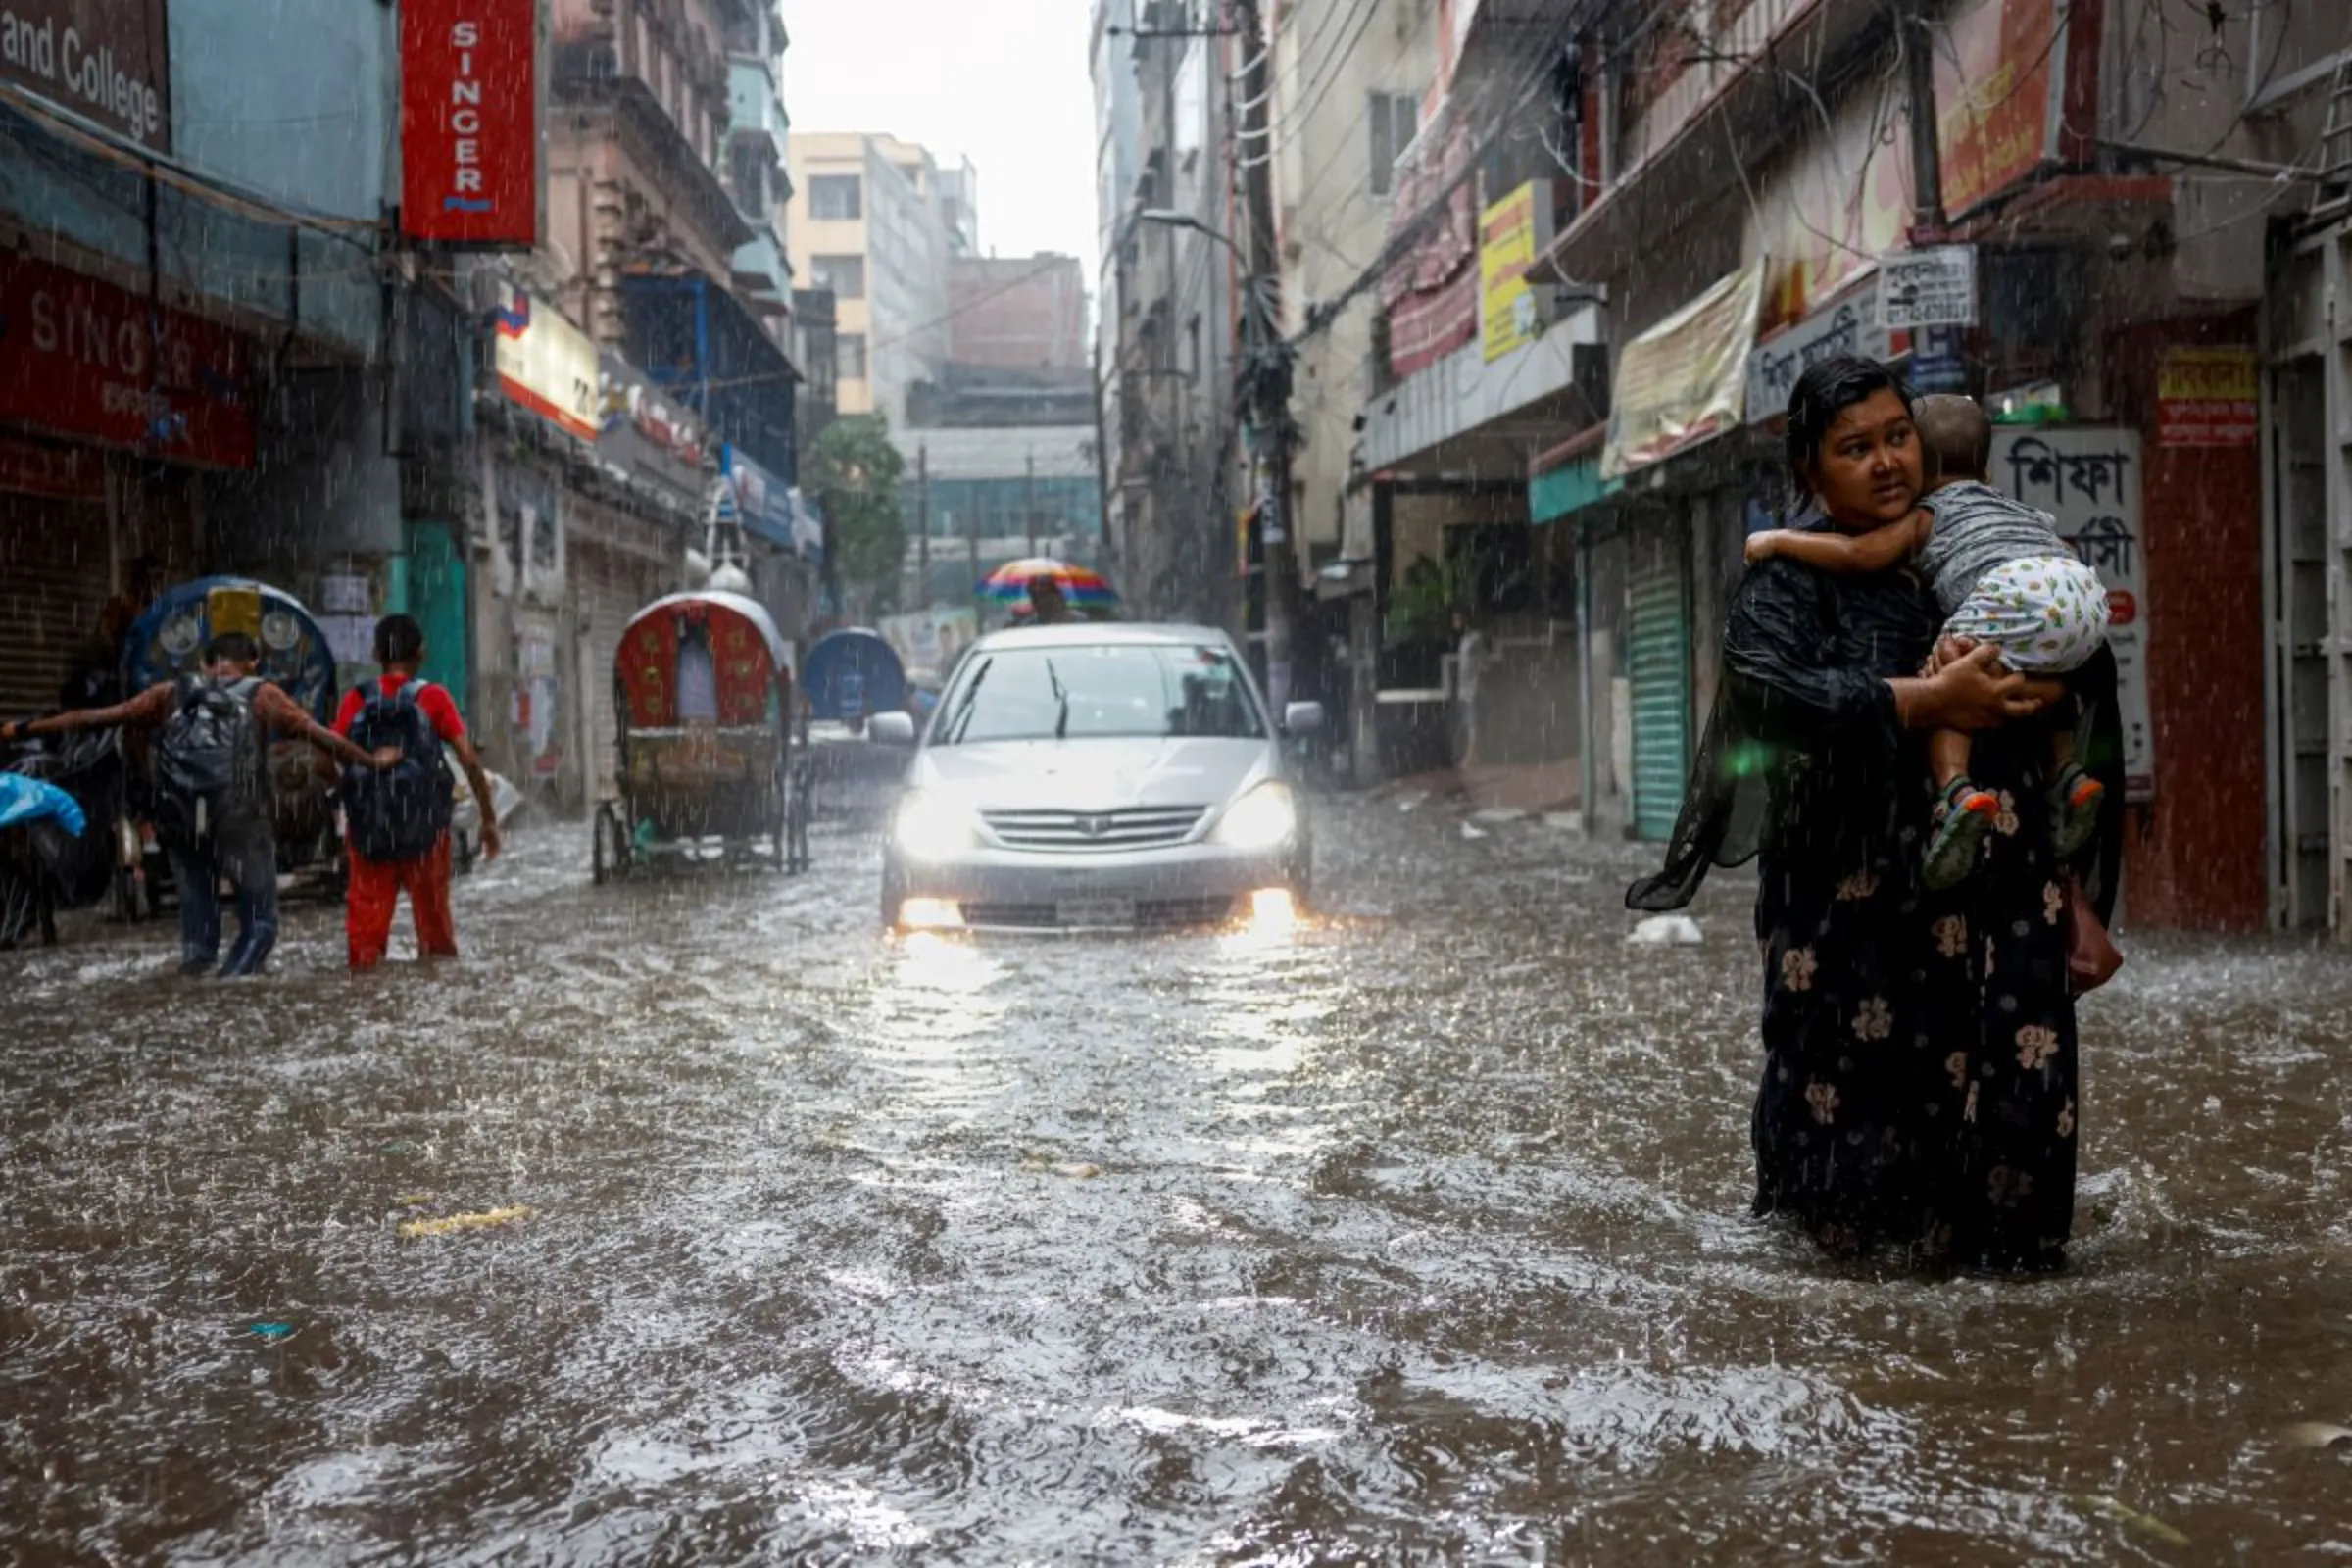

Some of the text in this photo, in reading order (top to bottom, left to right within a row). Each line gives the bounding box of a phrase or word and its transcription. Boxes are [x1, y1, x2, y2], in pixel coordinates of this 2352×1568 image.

[2, 10, 158, 144] and College
[452, 22, 481, 192] SINGER
[2005, 436, 2131, 506] শিফা
